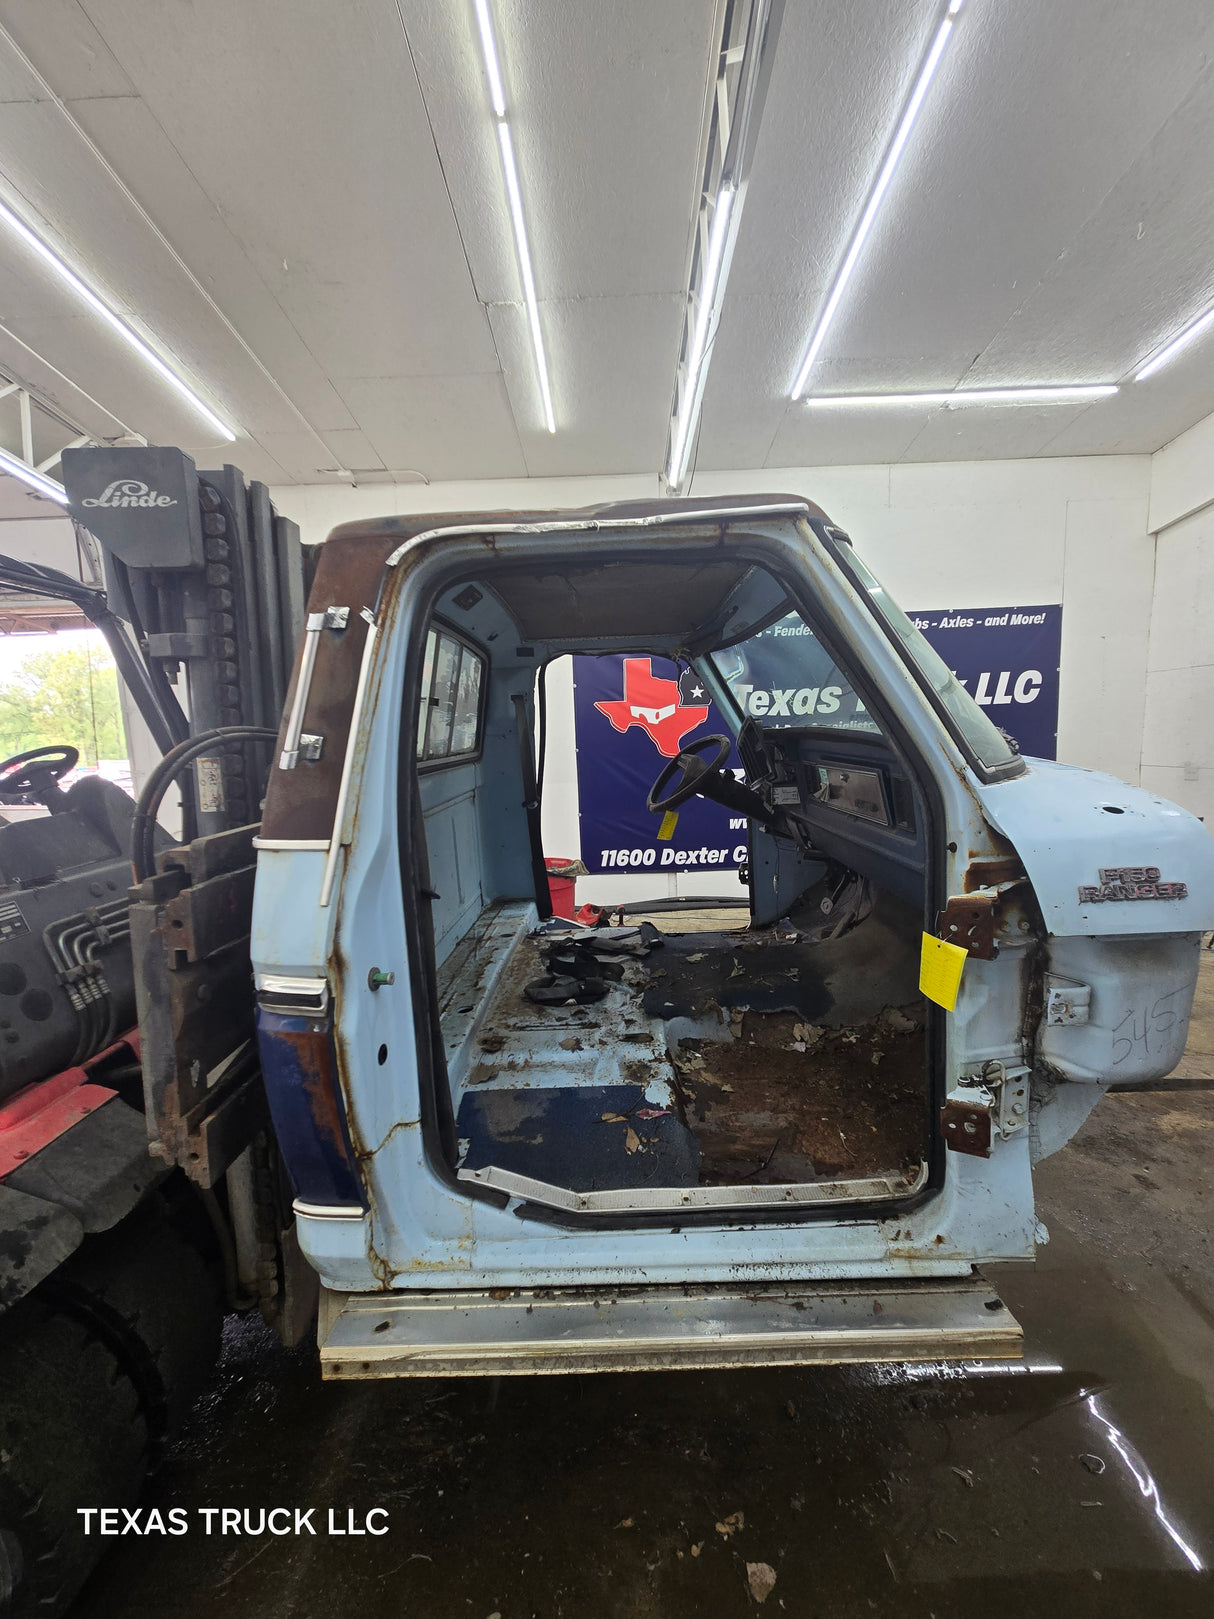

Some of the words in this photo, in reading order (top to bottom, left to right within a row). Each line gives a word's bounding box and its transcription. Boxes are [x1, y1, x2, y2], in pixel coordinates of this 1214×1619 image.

[81, 479, 178, 508] Linde
[938, 615, 974, 629] Axles
[984, 614, 1008, 627] and
[1010, 612, 1047, 625] More!
[733, 684, 843, 717] Texas
[974, 669, 1043, 706] LLC
[600, 848, 657, 867] 11600
[660, 847, 728, 866] Dexter
[1078, 882, 1188, 904] RANGER
[1111, 983, 1192, 1066] 545
